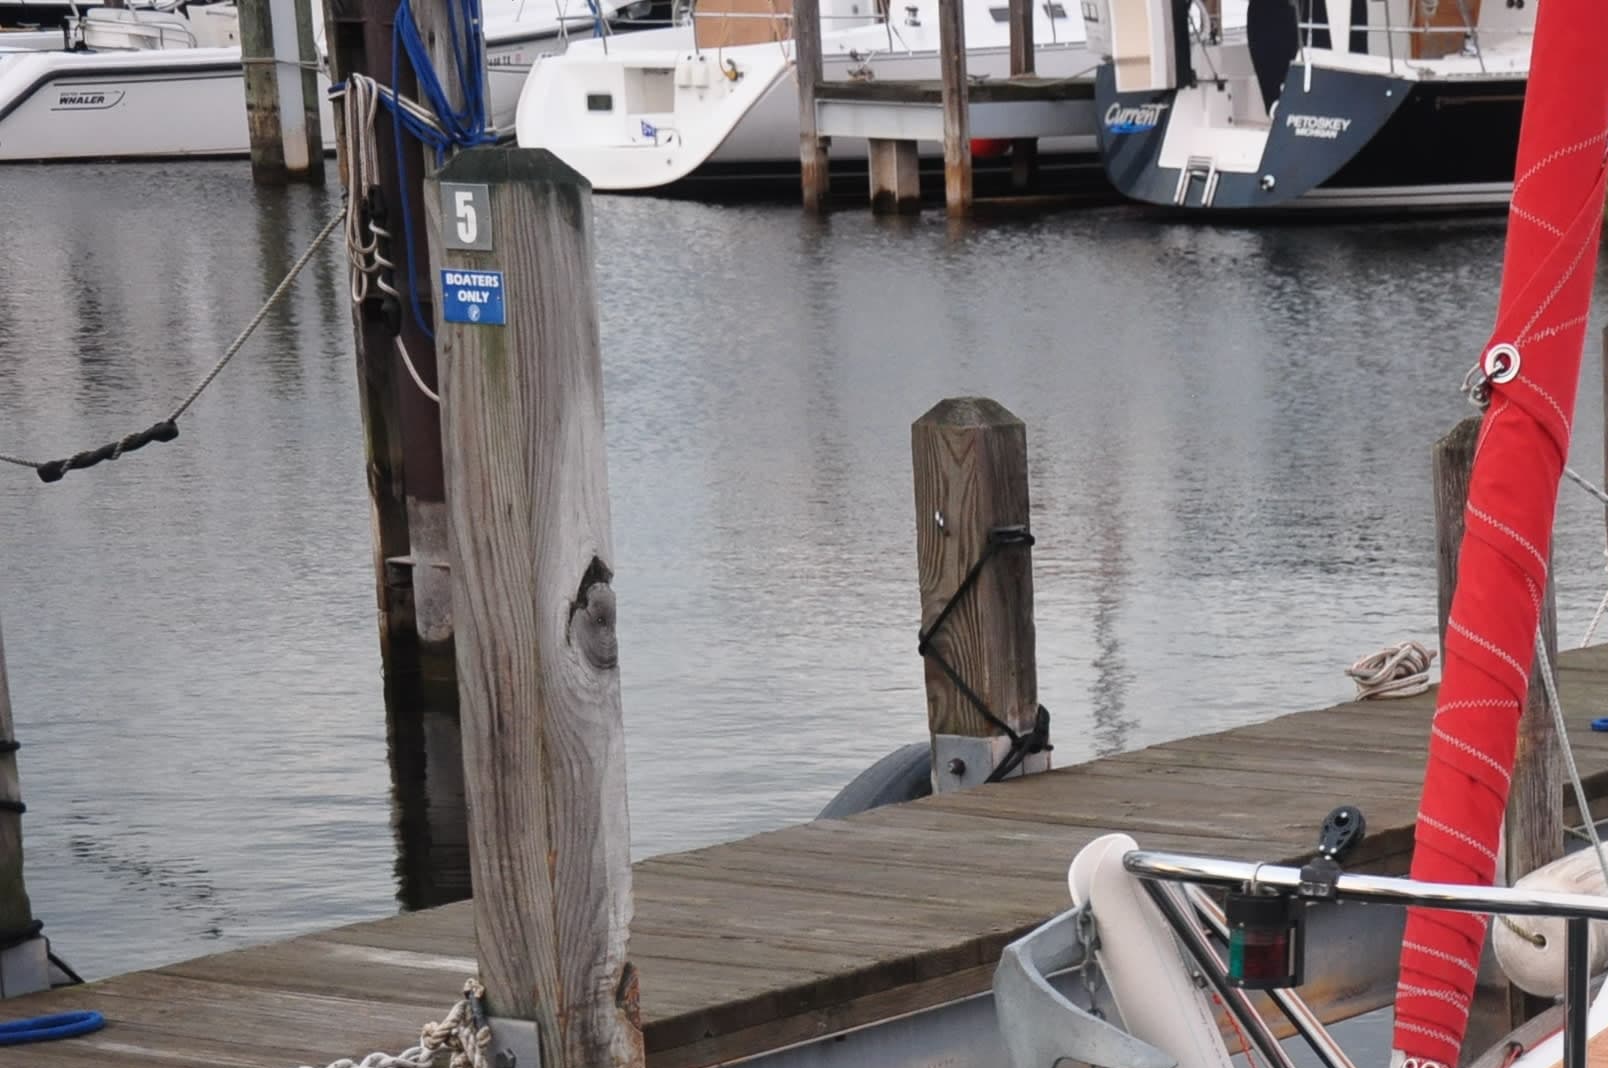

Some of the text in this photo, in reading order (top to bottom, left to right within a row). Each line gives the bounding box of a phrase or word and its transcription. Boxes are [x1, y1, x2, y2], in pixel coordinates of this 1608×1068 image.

[59, 95, 105, 105] WHALER
[1286, 114, 1352, 131] PETOSKEY
[455, 191, 477, 244] 5
[445, 273, 499, 288] BOATERS
[457, 290, 490, 304] ONLY
